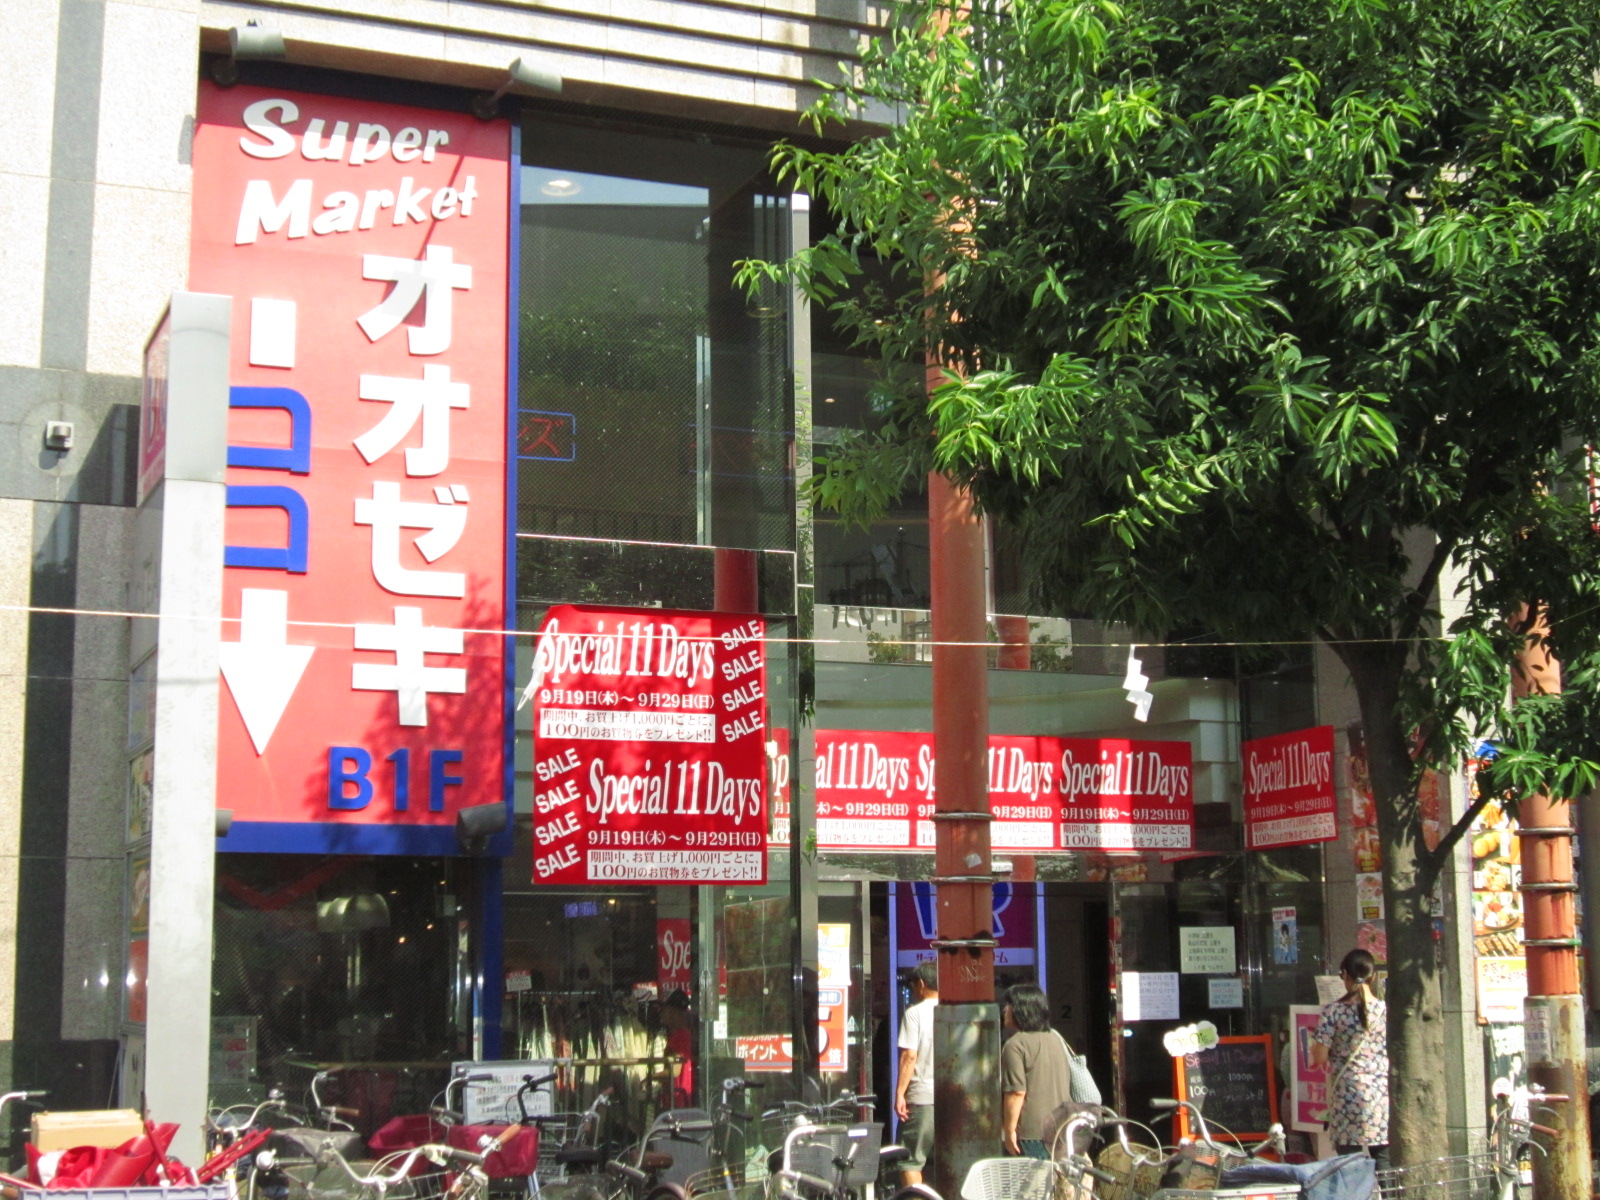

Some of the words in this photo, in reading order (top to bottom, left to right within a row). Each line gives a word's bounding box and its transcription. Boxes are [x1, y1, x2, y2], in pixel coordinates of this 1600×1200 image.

[240, 98, 449, 166] Super
[235, 176, 477, 246] Market
[352, 245, 474, 727] オオゼキ
[541, 617, 622, 683] Special
[626, 623, 655, 677] 11
[657, 624, 715, 687] Days
[721, 619, 764, 651] SALE
[721, 650, 764, 681] SALE
[722, 680, 764, 712] SALE
[722, 711, 764, 743] SALE
[328, 746, 464, 812] B1F
[535, 748, 582, 782] SALE
[586, 757, 671, 825] Special
[673, 760, 702, 815] 11
[704, 761, 761, 826] Days
[836, 742, 858, 789] 11
[861, 743, 910, 798] Days
[1009, 747, 1053, 802] Days
[1060, 749, 1121, 803] Special
[1123, 751, 1144, 795] 11
[1146, 752, 1189, 803] Days
[1249, 745, 1286, 802] Special
[1288, 742, 1299, 788] 11
[1301, 741, 1331, 792] Days
[535, 780, 581, 814] SALE
[535, 812, 581, 846] SALE
[535, 844, 581, 879] SALE
[738, 1044, 778, 1060] ポイント
